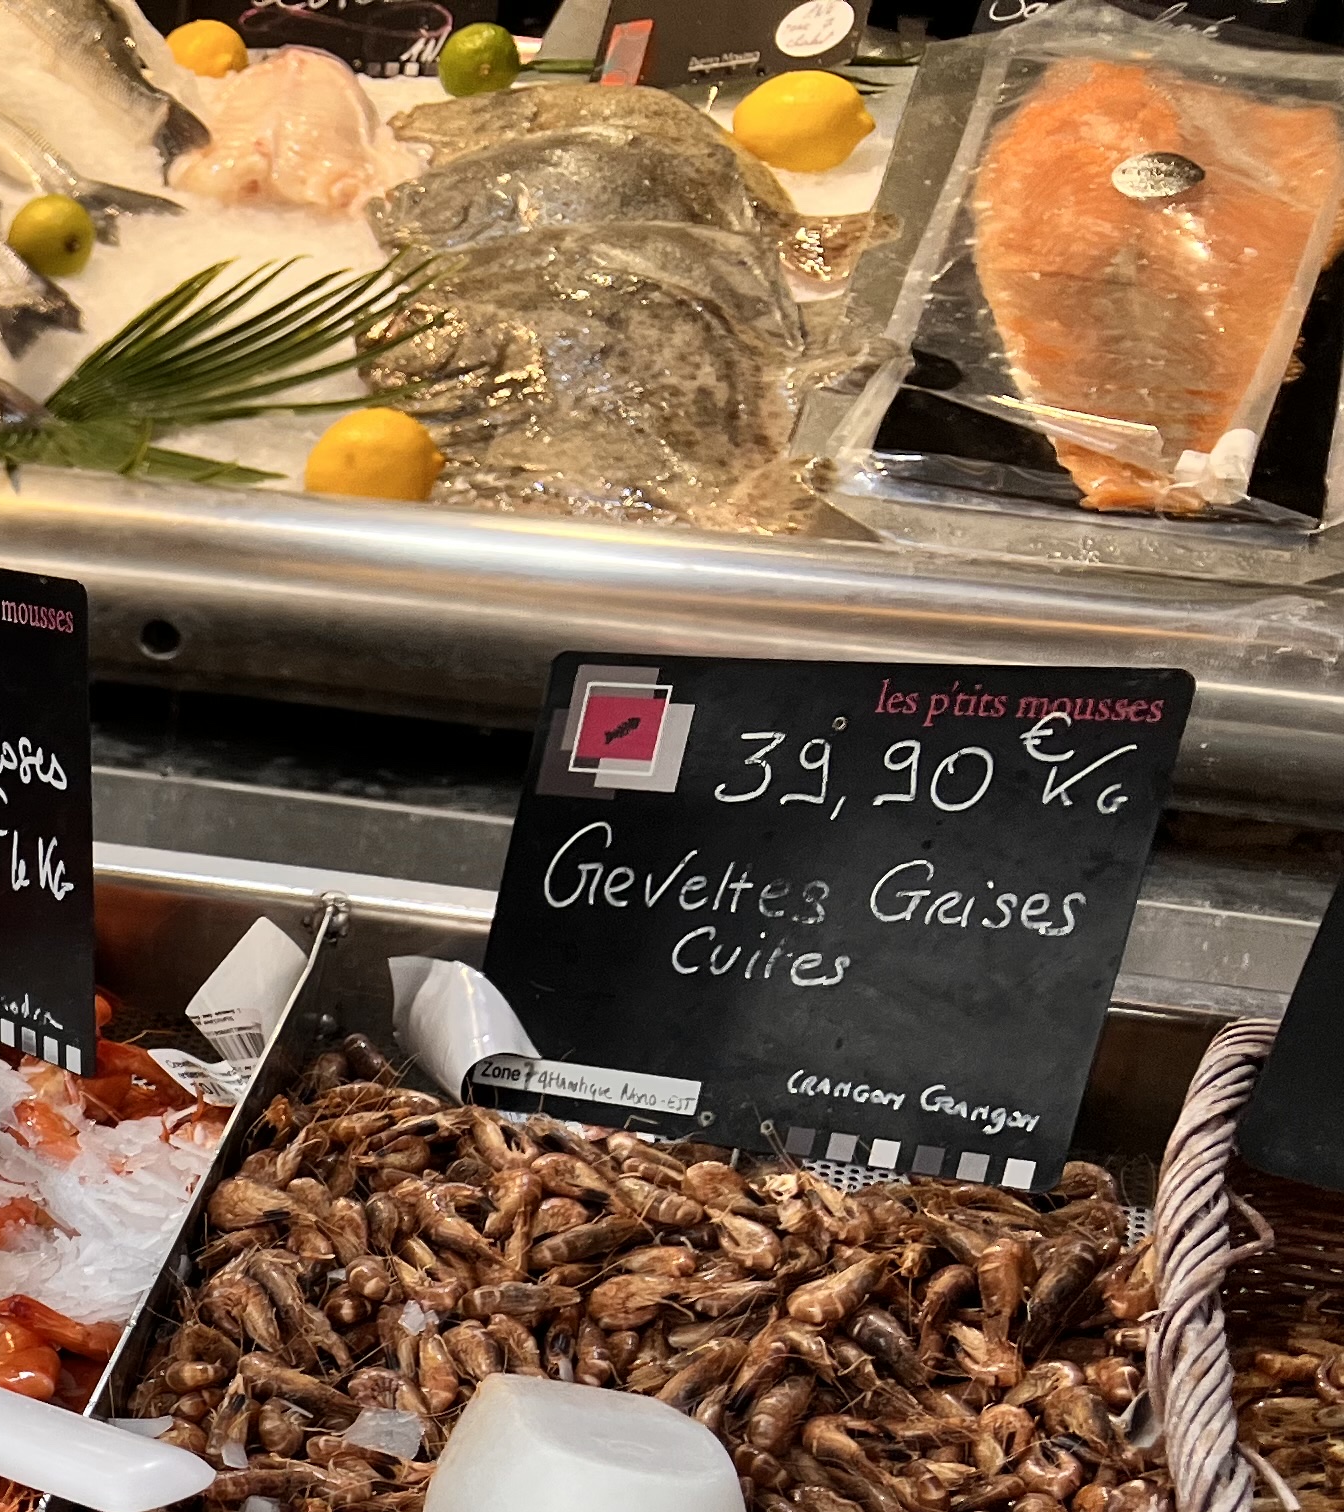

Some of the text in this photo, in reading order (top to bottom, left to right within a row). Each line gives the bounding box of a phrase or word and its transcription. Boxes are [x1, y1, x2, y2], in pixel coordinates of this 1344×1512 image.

[1, 600, 75, 634] mousses
[875, 679, 1165, 727] les p'tits mousses
[714, 729, 995, 820] 39,90
[481, 1060, 521, 1082] Zone
